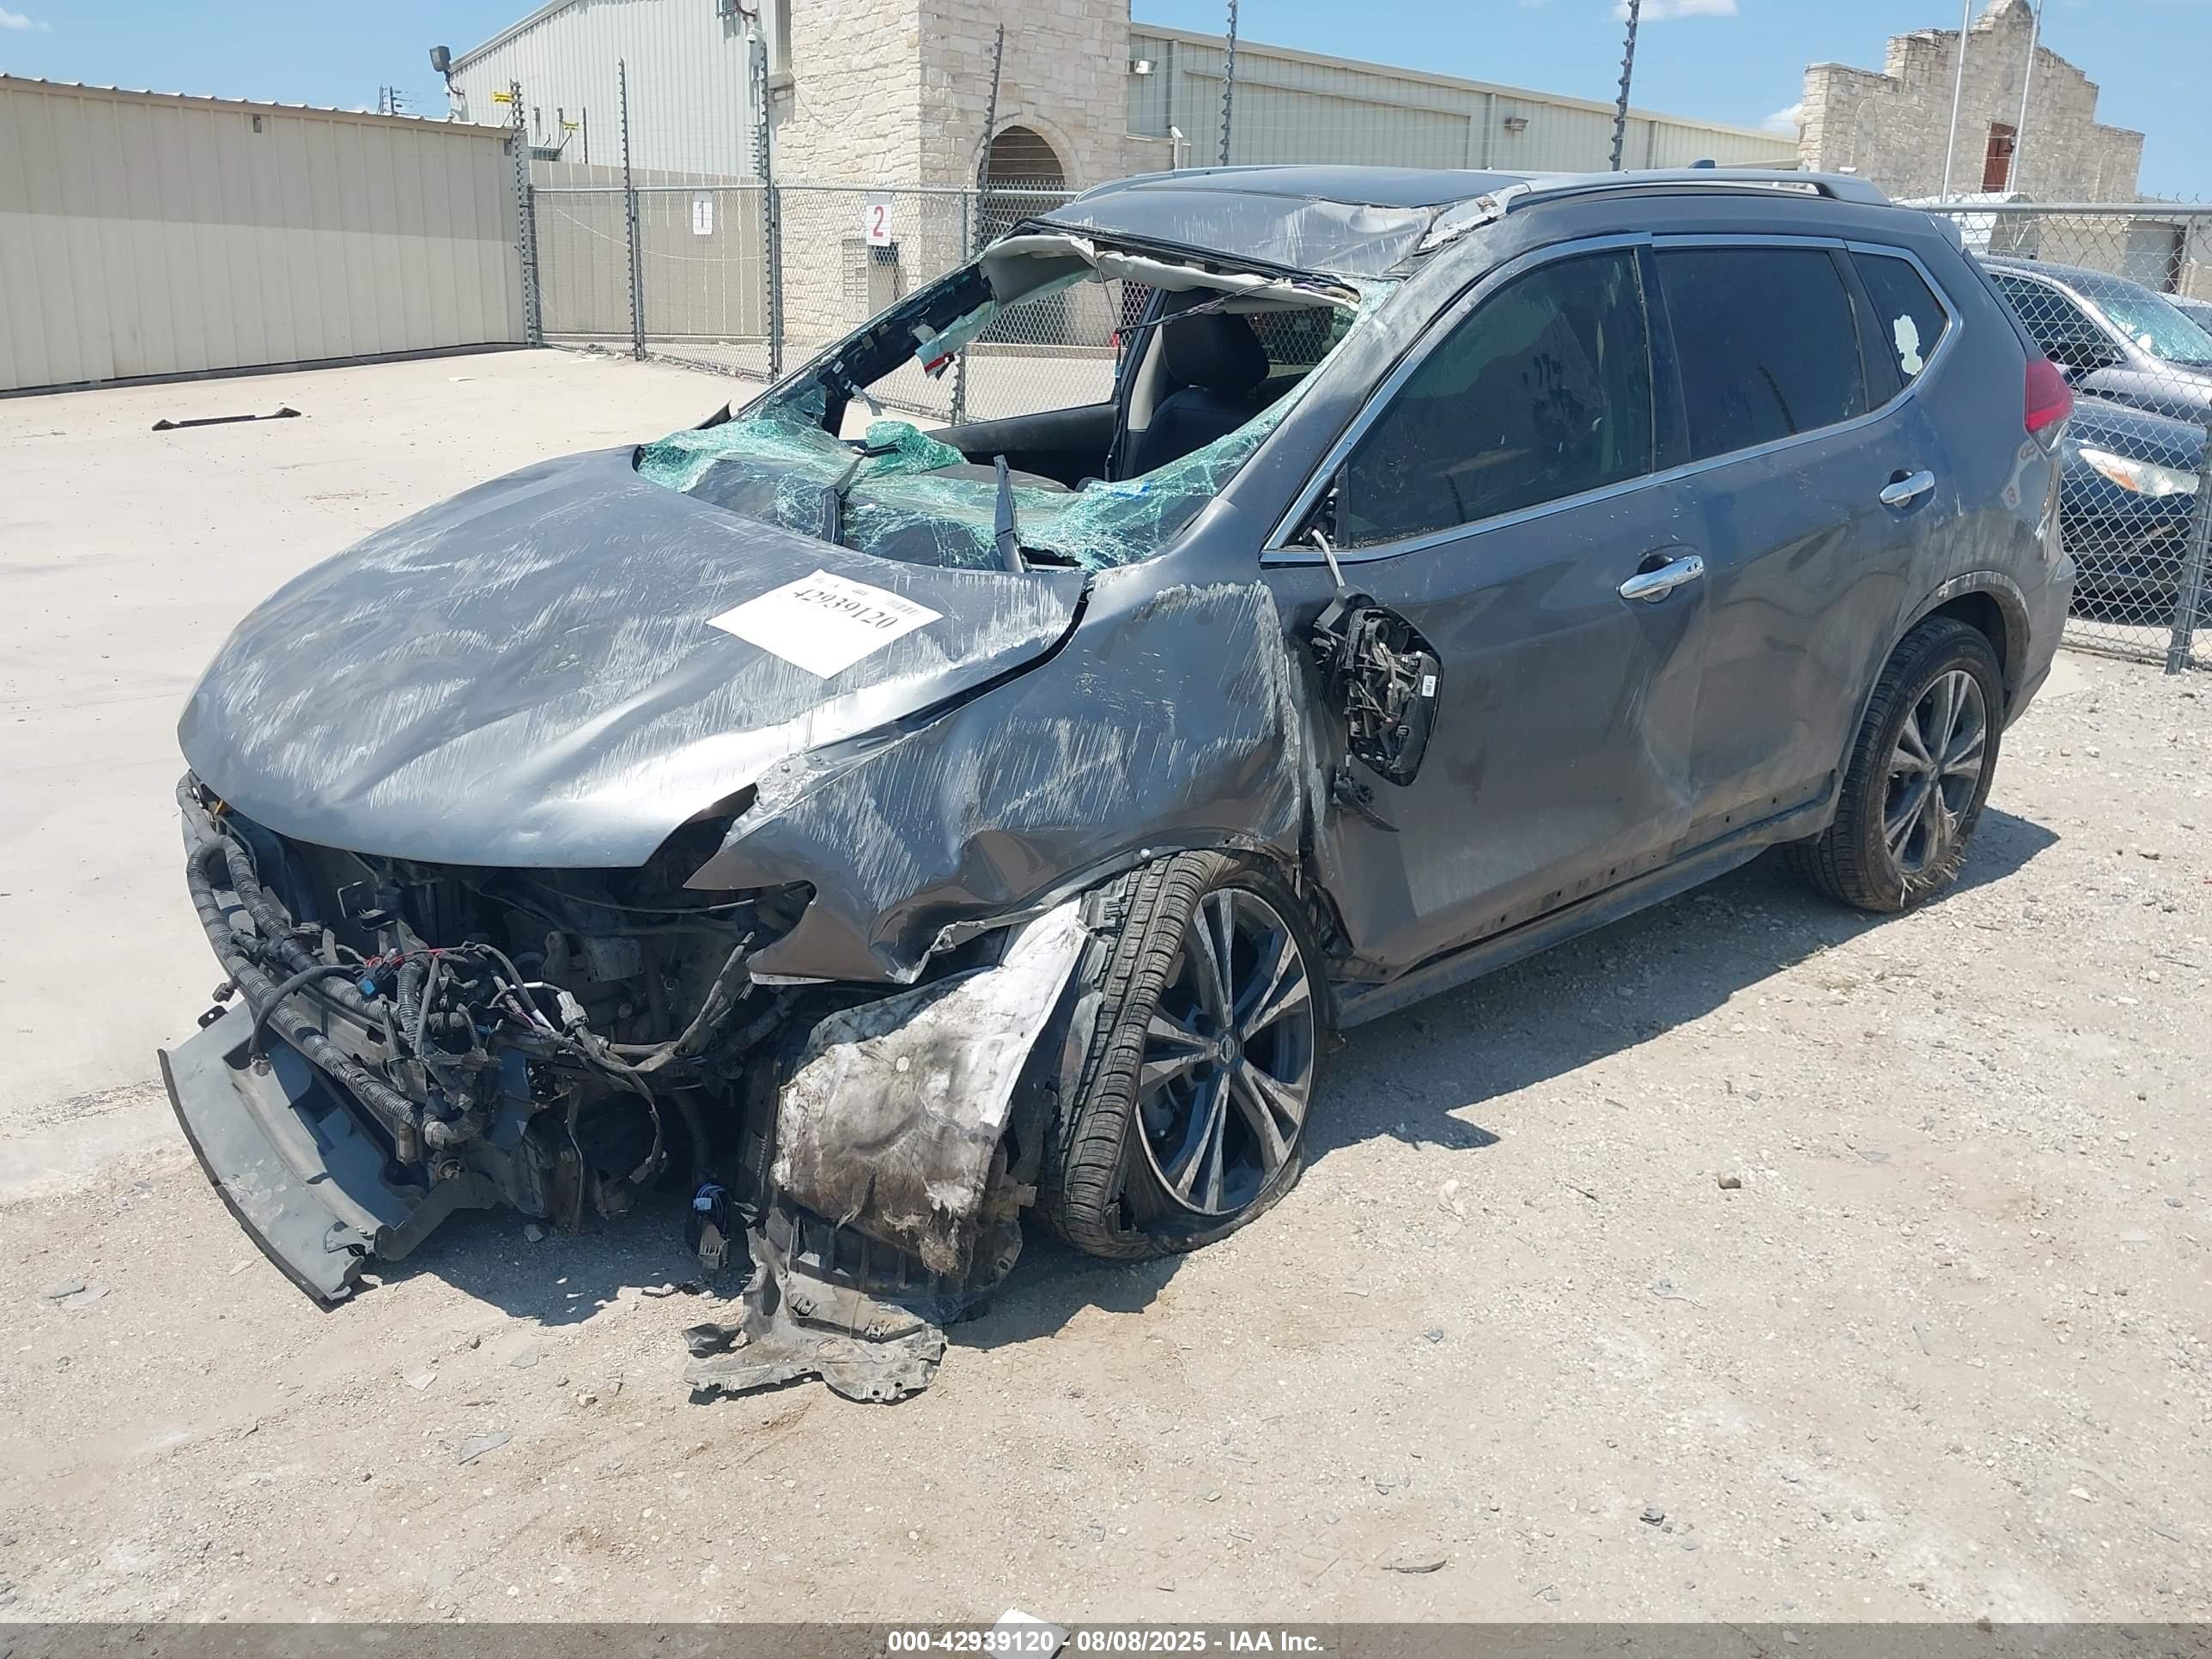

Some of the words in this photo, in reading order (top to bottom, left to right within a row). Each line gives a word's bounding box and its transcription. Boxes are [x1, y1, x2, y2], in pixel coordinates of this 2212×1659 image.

[697, 200, 704, 228] 1
[872, 205, 884, 237] 2
[793, 588, 898, 629] 42939120
